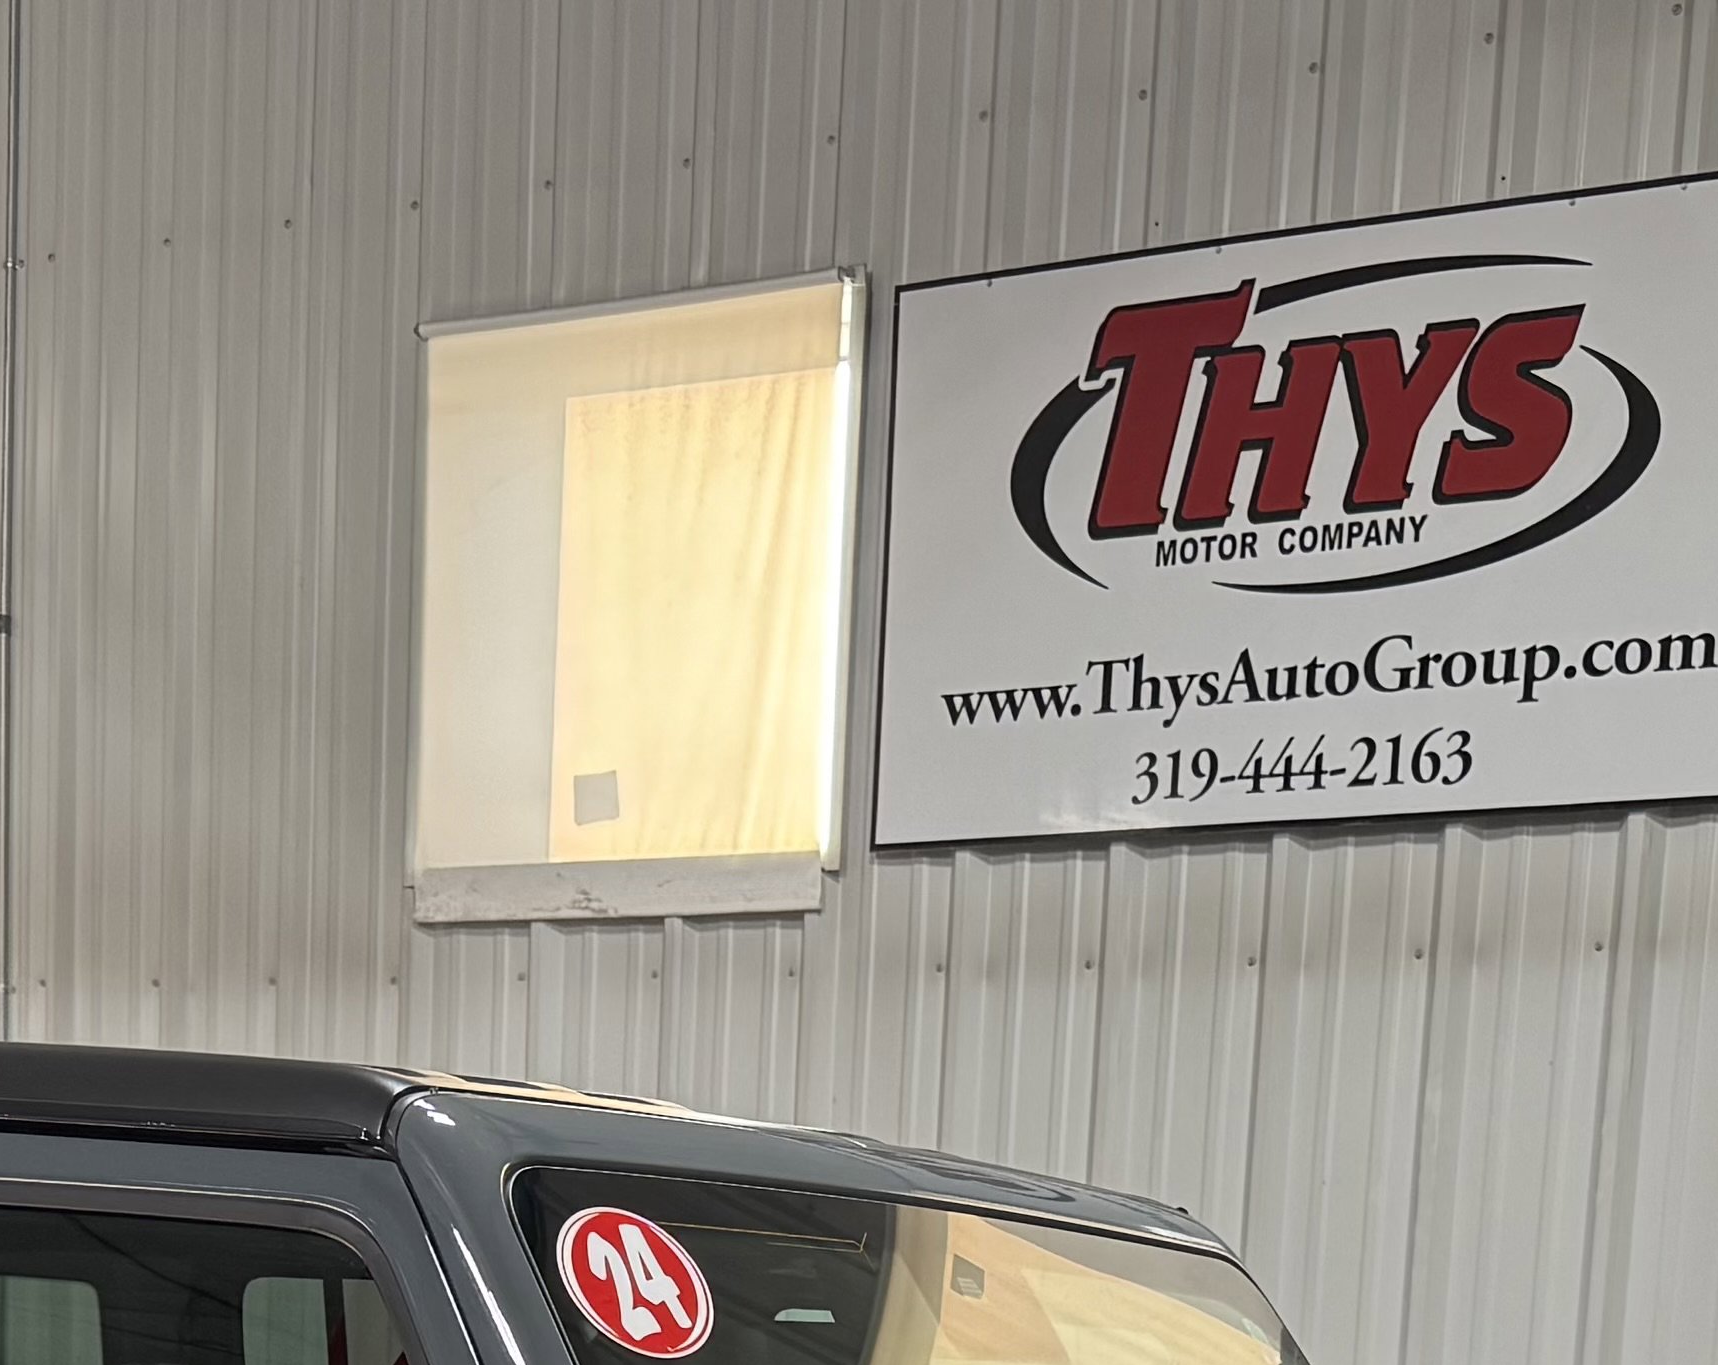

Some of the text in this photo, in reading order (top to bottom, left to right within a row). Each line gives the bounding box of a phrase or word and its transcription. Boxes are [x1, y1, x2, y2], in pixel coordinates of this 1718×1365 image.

[1082, 278, 1587, 540] THYS
[1154, 513, 1429, 569] MOTOR COMPANY
[940, 626, 1718, 728] www.ThysAutoGroup.com
[1130, 728, 1474, 806] 319-444-2163
[587, 1223, 693, 1341] 24
